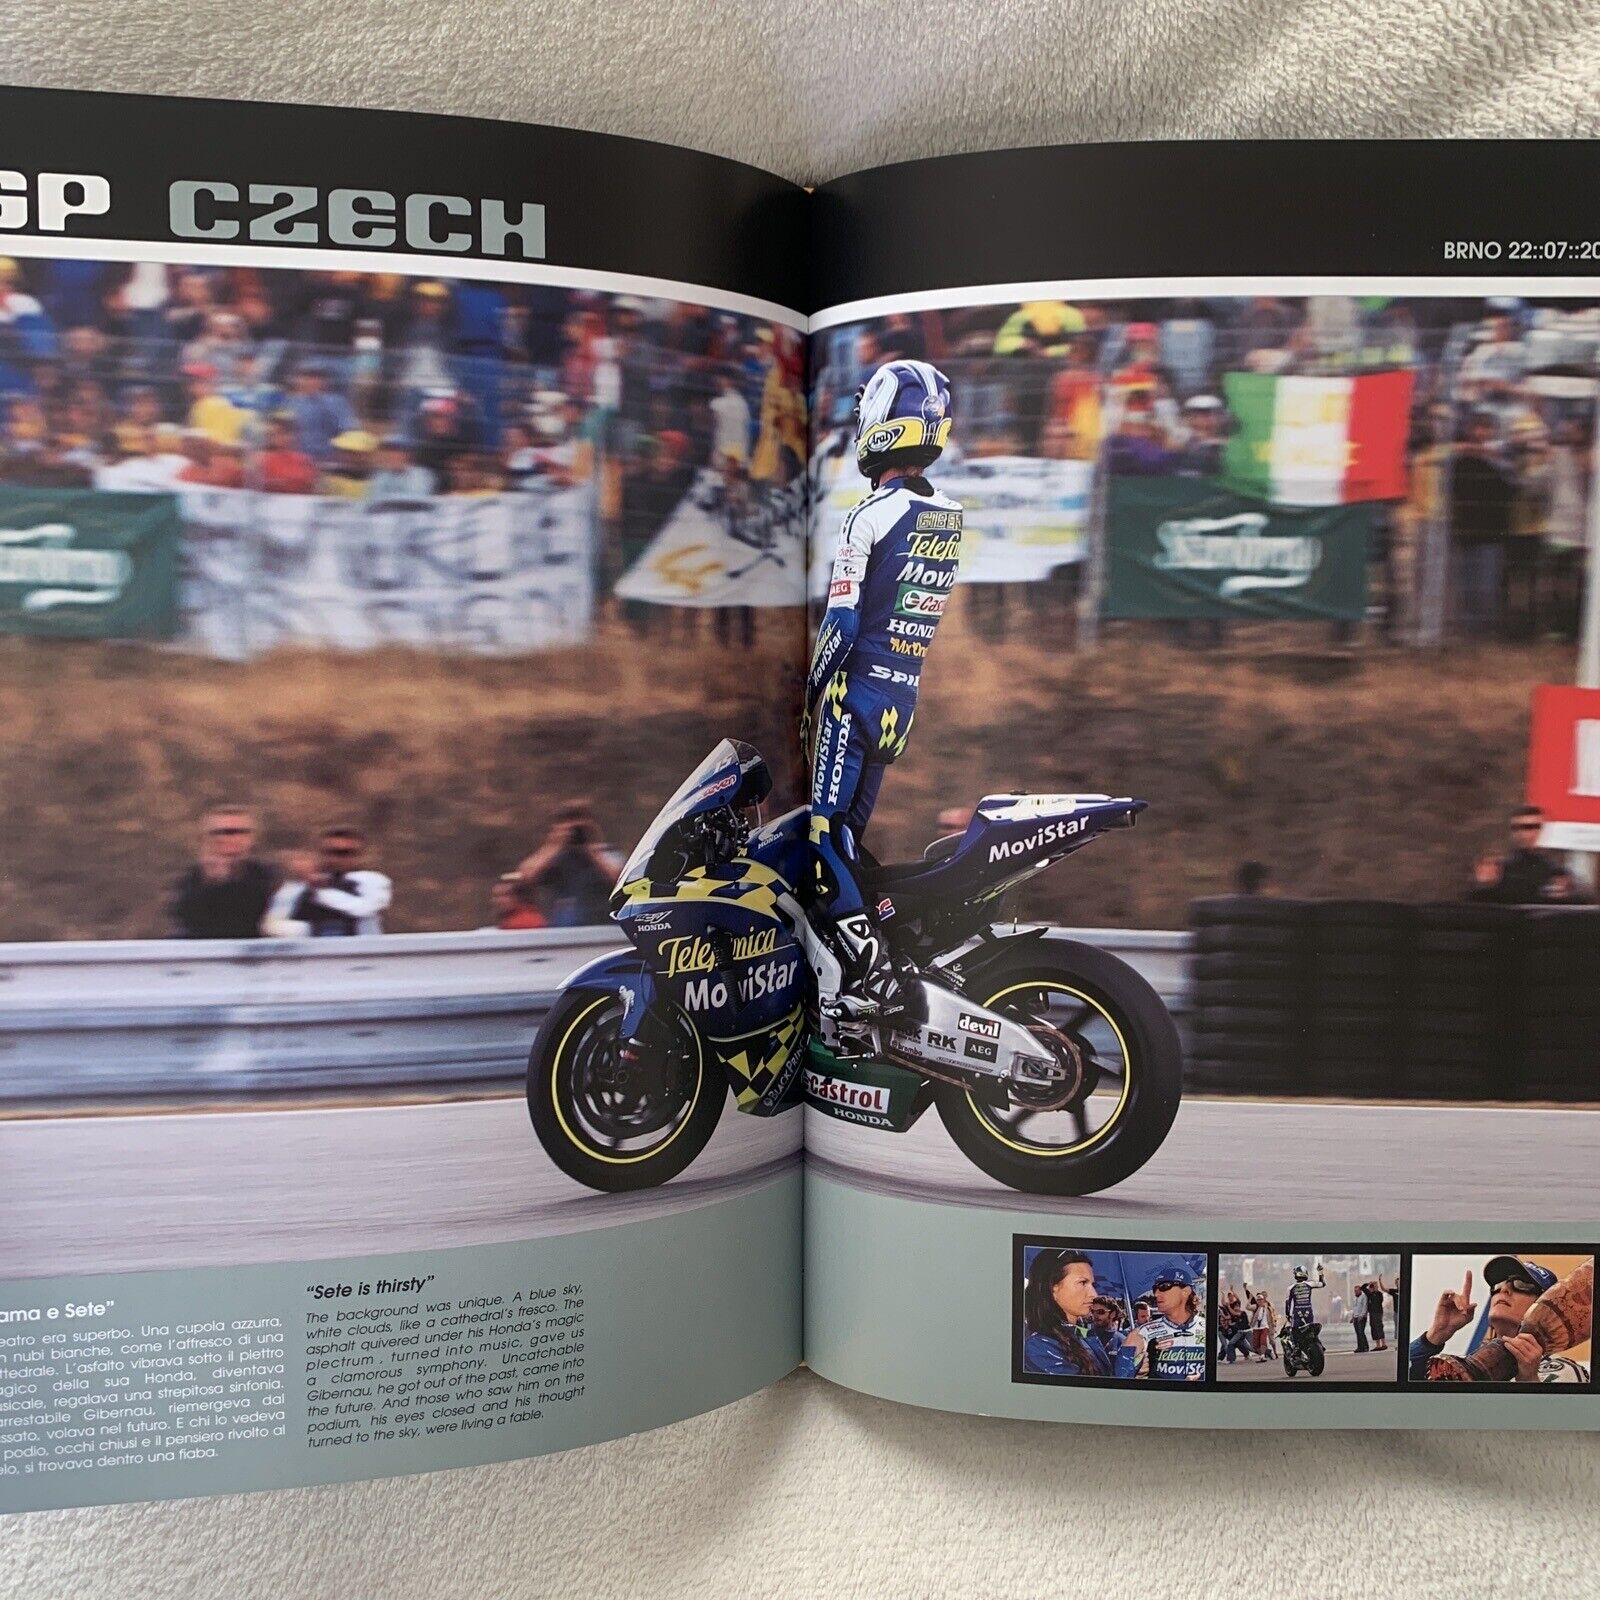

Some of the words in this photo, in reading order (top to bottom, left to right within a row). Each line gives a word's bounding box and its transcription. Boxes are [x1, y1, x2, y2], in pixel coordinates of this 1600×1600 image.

[168, 180, 546, 259] CZECH
[1444, 241, 1502, 260] BRNO
[813, 717, 833, 805] MoviStar
[828, 712, 852, 806] HONDA
[757, 831, 784, 850] HONDA
[988, 815, 1089, 863] MoviStar
[637, 922, 672, 932] HONDA
[658, 927, 777, 978] Telenica
[684, 960, 798, 1012] MoviStar
[927, 1031, 957, 1050] RK
[958, 1015, 1000, 1038] devil
[969, 1044, 992, 1056] AEG
[809, 1075, 884, 1110] Castrol
[833, 1107, 895, 1128] HONDA
[357, 1281, 370, 1295] is
[46, 1307, 59, 1319] e
[306, 1312, 328, 1323] The
[336, 1303, 418, 1321] background
[425, 1301, 451, 1312] was
[511, 1291, 522, 1302] A
[529, 1288, 556, 1300] blue
[306, 1326, 341, 1339] white
[399, 1319, 420, 1331] like
[425, 1318, 435, 1328] a
[564, 1298, 584, 1309] The
[41, 1333, 66, 1343] era
[141, 1325, 169, 1336] Una
[175, 1320, 224, 1334] cupola
[305, 1340, 355, 1356] asphalt
[360, 1333, 419, 1351] quivered
[424, 1330, 463, 1343] under
[467, 1327, 483, 1338] his
[545, 1312, 584, 1327] magic
[13, 1349, 44, 1362] nubi
[120, 1342, 162, 1354] come
[237, 1333, 250, 1345] di
[256, 1333, 283, 1343] una
[130, 1356, 182, 1368] vibrava
[188, 1352, 222, 1364] sotto
[227, 1350, 233, 1361] il
[239, 1348, 283, 1362] plettro
[305, 1355, 373, 1372] plectrum
[391, 1346, 440, 1362] turned
[445, 1343, 473, 1356] into
[529, 1332, 565, 1348] gave
[570, 1328, 584, 1338] us
[52, 1378, 89, 1391] della
[104, 1376, 129, 1387] sua
[212, 1364, 284, 1378] diventava
[306, 1376, 316, 1386] a
[331, 1368, 402, 1383] clamorous
[502, 1342, 584, 1364] Uncatchable
[377, 1383, 394, 1394] he
[397, 1379, 420, 1394] got
[423, 1376, 445, 1389] out
[448, 1374, 463, 1386] of
[465, 1373, 485, 1384] the
[522, 1362, 559, 1376] came
[562, 1357, 584, 1369] into
[53, 1393, 118, 1408] regalava
[124, 1390, 151, 1401] una
[157, 1385, 223, 1398] strepitosa
[168, 1398, 250, 1412] riemergeva
[262, 1393, 284, 1405] dal
[307, 1405, 329, 1416] the
[381, 1395, 410, 1409] And
[415, 1393, 450, 1405] those
[455, 1389, 482, 1400] who
[487, 1385, 512, 1396] saw
[517, 1380, 539, 1392] him
[544, 1377, 560, 1387] on
[565, 1372, 584, 1383] the
[370, 1414, 387, 1425] his
[394, 1411, 424, 1423] eyes
[432, 1403, 475, 1418] closed
[482, 1398, 508, 1412] and
[514, 1395, 530, 1407] his
[538, 1385, 584, 1403] thought
[46, 1427, 94, 1439] volava
[100, 1422, 121, 1434] nel
[176, 1416, 183, 1428] E
[188, 1415, 210, 1427] chi
[215, 1412, 227, 1425] lo
[232, 1411, 285, 1423] vedeva
[54, 1440, 94, 1454] occhi
[99, 1437, 137, 1450] chiusi
[141, 1438, 151, 1447] e
[155, 1434, 161, 1445] il
[165, 1431, 224, 1447] pensiero
[228, 1426, 268, 1439] rivolto
[272, 1424, 285, 1435] al
[308, 1433, 352, 1447] turned
[356, 1432, 369, 1442] to
[373, 1429, 394, 1440] the
[425, 1422, 457, 1434] were
[460, 1417, 493, 1429] living
[496, 1415, 506, 1425] a
[24, 1461, 34, 1473] si
[38, 1459, 92, 1471] trovava
[96, 1454, 143, 1466] dentro
[147, 1451, 174, 1462] una
